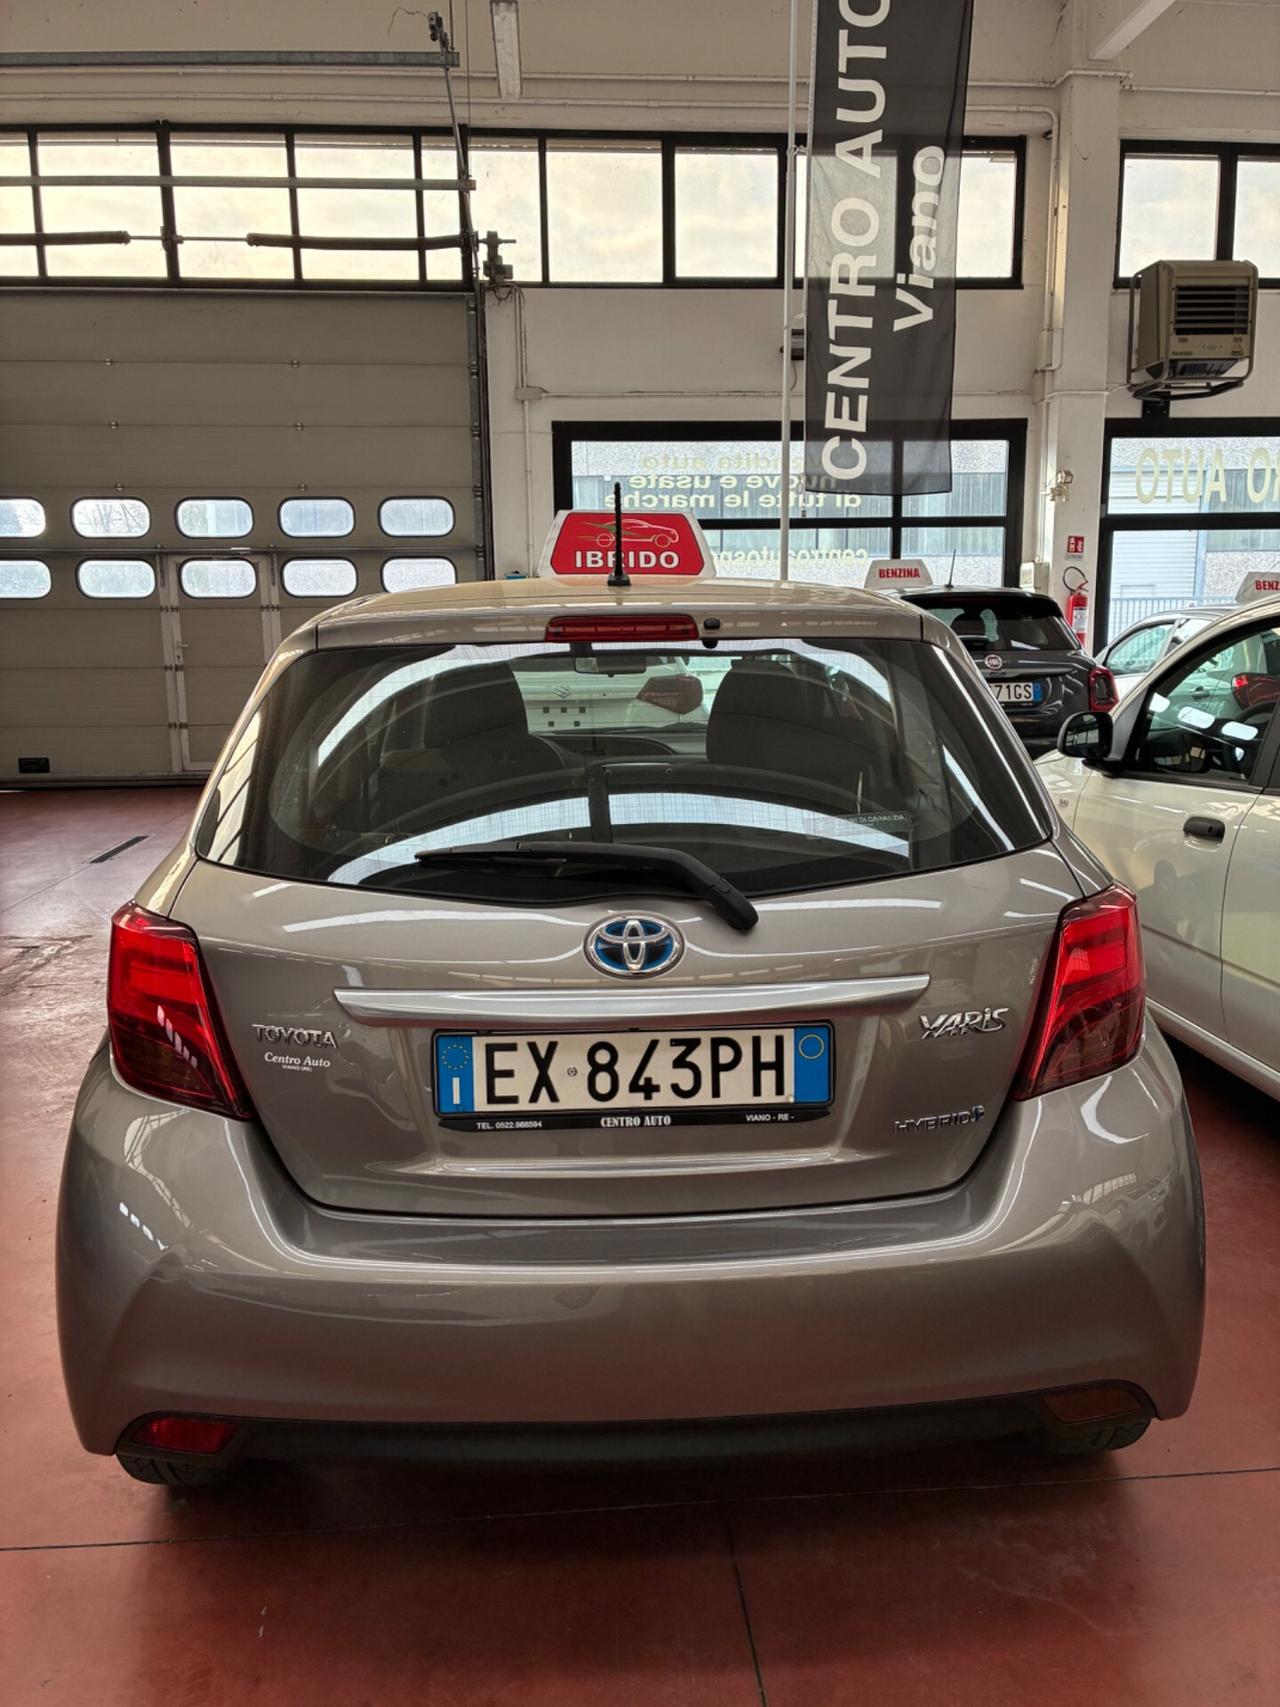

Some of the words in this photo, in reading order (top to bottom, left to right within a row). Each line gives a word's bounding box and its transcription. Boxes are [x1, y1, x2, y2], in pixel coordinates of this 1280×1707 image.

[835, 0, 890, 178] AUTO
[893, 145, 945, 332] Viano
[821, 197, 880, 480] CENTRO
[575, 550, 680, 569] IBRIDO
[878, 567, 921, 579] BENZINA
[990, 684, 1033, 700] 71GS
[252, 1024, 338, 1049] TOYOTA
[264, 1052, 300, 1065] Centro
[303, 1056, 331, 1067] Auto
[485, 1040, 561, 1105] EX
[586, 1034, 785, 1103] 843PH
[600, 1116, 640, 1128] CENTRO
[643, 1115, 672, 1126] AUTO
[745, 1113, 771, 1122] VIANO
[895, 1110, 971, 1134] HYBRID
